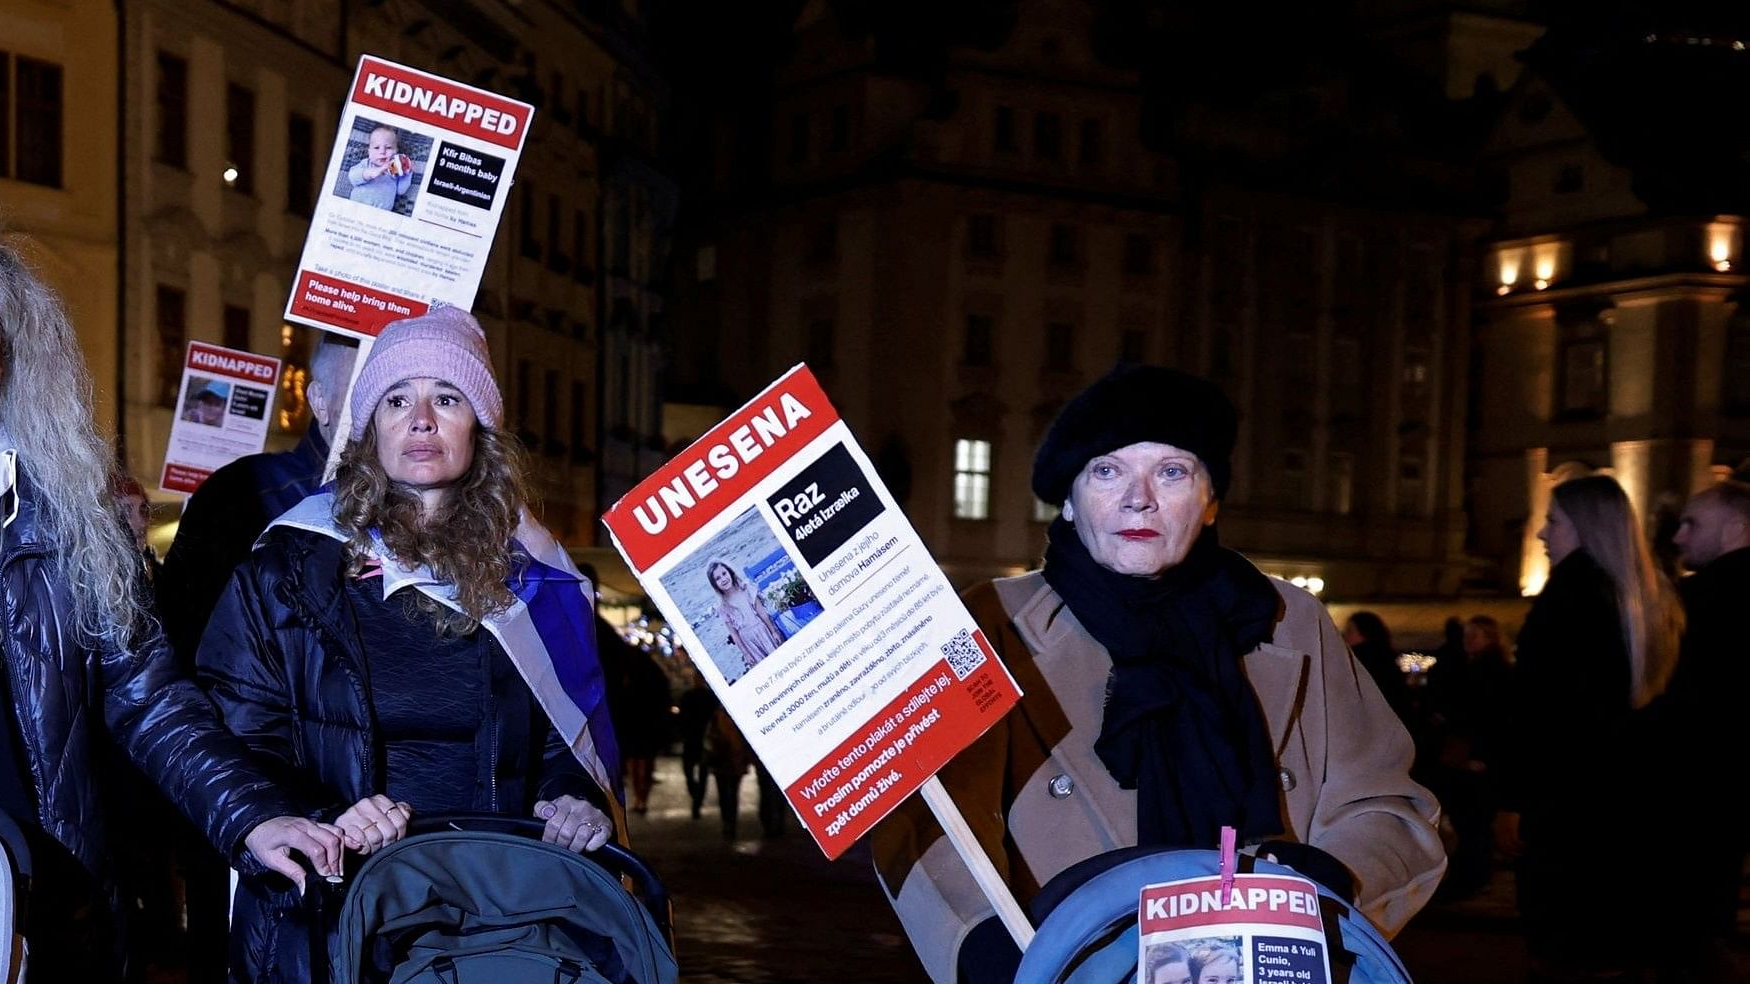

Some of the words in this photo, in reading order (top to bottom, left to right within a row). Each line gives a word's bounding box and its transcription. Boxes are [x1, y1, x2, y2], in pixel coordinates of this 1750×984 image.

[363, 72, 516, 135] KIDNAPPED
[439, 157, 445, 166] 9
[445, 161, 476, 175] months
[476, 168, 498, 183] baby
[442, 146, 458, 158] Kfir
[458, 151, 482, 165] Bibas
[304, 291, 331, 306] home
[332, 300, 356, 313] alive.
[308, 279, 339, 295] Please
[340, 288, 361, 302] help
[361, 293, 386, 310] bring
[387, 301, 410, 315] them
[192, 351, 273, 378] KIDNAPPED
[632, 392, 811, 534] UNESENA
[773, 481, 826, 527] Raz
[795, 513, 824, 540] 4letá
[817, 552, 854, 582] Unesena
[852, 547, 859, 556] z
[828, 567, 860, 596] domova
[857, 536, 898, 571] Hamásem
[754, 703, 769, 718] 200
[768, 679, 801, 707] nevinných
[759, 721, 775, 735] Více
[774, 711, 787, 724] než
[785, 697, 805, 714] 3000
[817, 672, 835, 690] mužů
[799, 766, 840, 799] Vyfoťte
[837, 743, 867, 769] tento
[864, 717, 897, 750] plakát
[895, 712, 904, 723] a
[902, 684, 938, 717] sdílejte
[933, 671, 951, 692] jej.
[813, 782, 854, 817] Prosím
[850, 746, 896, 790] pomozte
[892, 738, 906, 754] je
[903, 707, 940, 745] přivést
[824, 810, 851, 836] zpět
[848, 786, 880, 816] domů
[875, 768, 902, 793] živé.
[1146, 889, 1318, 920] KIDNAPPED
[1257, 943, 1290, 955] Emma
[1291, 945, 1299, 955] &
[1299, 945, 1317, 957] Yuli
[1258, 954, 1291, 967] Cunio,
[1258, 966, 1265, 977] 3
[1267, 970, 1294, 981] years
[1295, 969, 1311, 981] old
